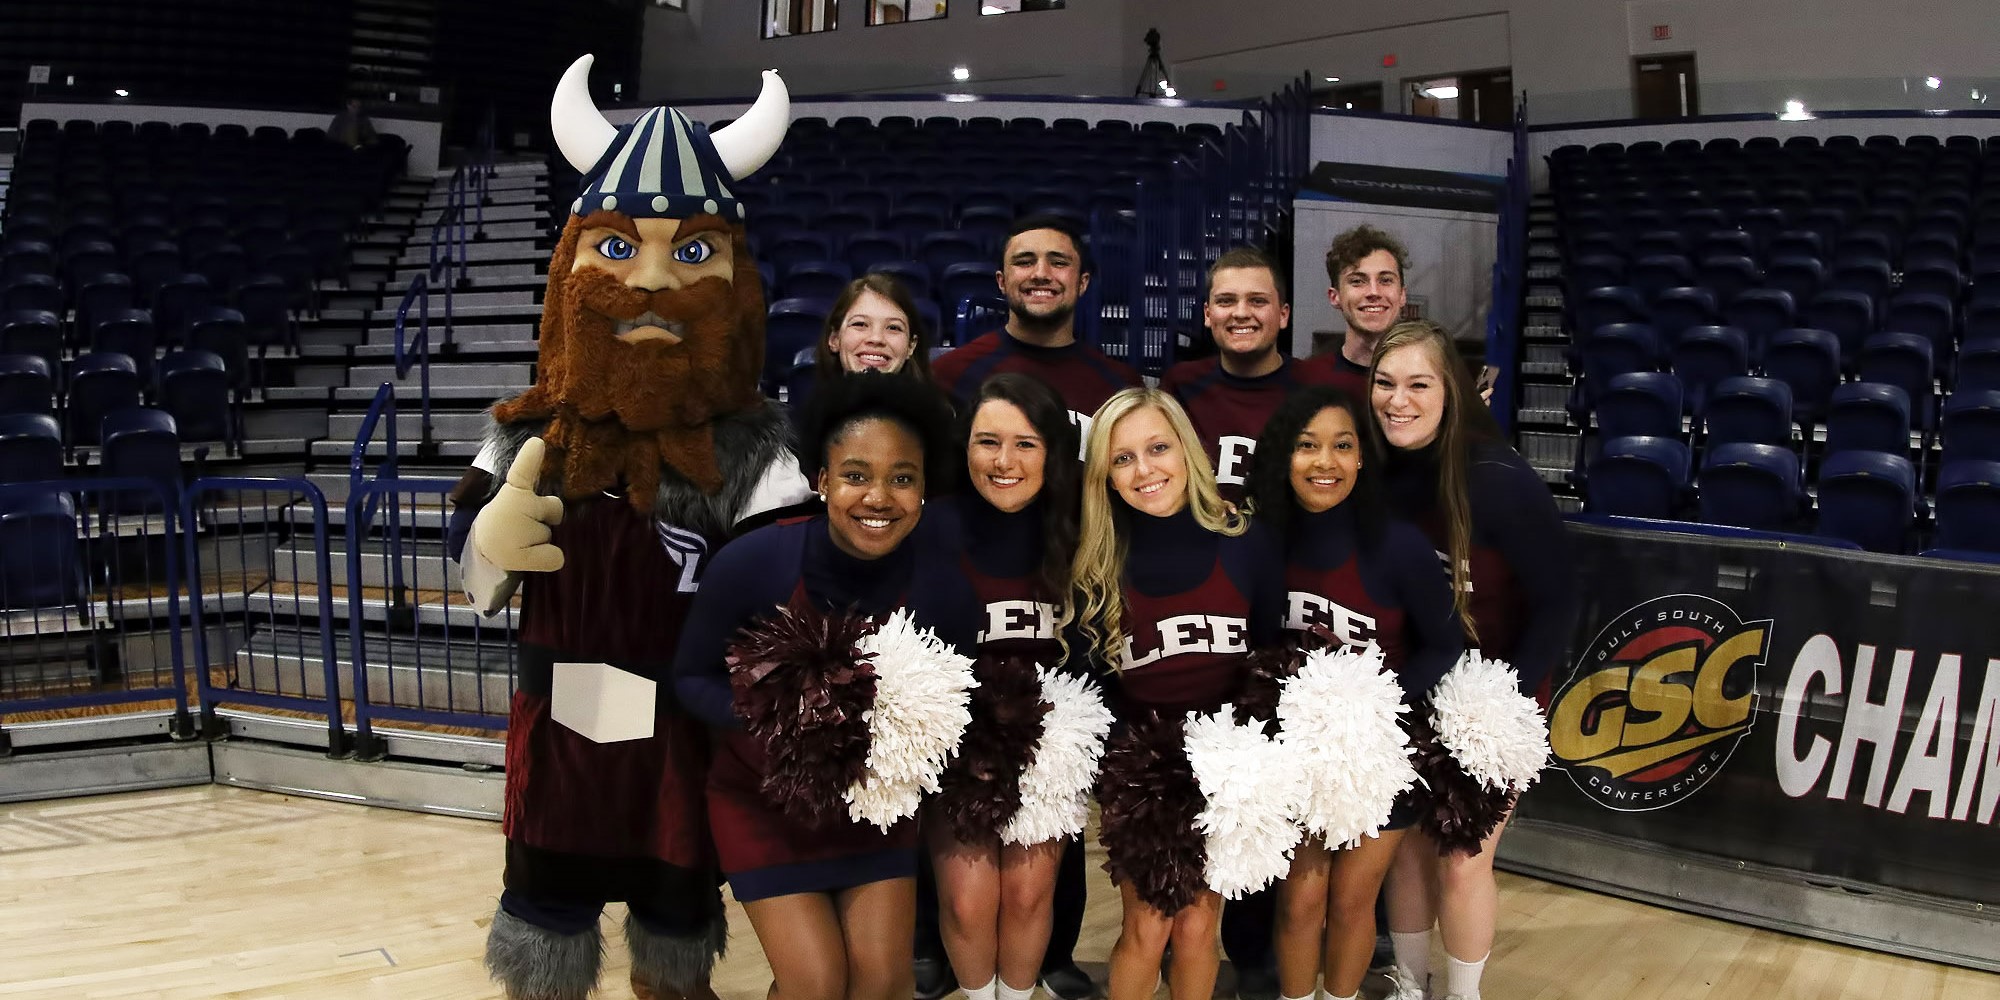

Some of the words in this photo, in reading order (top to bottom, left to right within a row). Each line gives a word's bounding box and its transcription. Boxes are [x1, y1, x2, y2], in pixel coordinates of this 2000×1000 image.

[1120, 614, 1248, 671] LEE
[1280, 591, 1377, 648] EE
[1597, 618, 1644, 661] GULF
[1657, 610, 1725, 634] SOUTH
[1550, 628, 1764, 761] GSC
[1588, 750, 1720, 801] CONFERENCE
